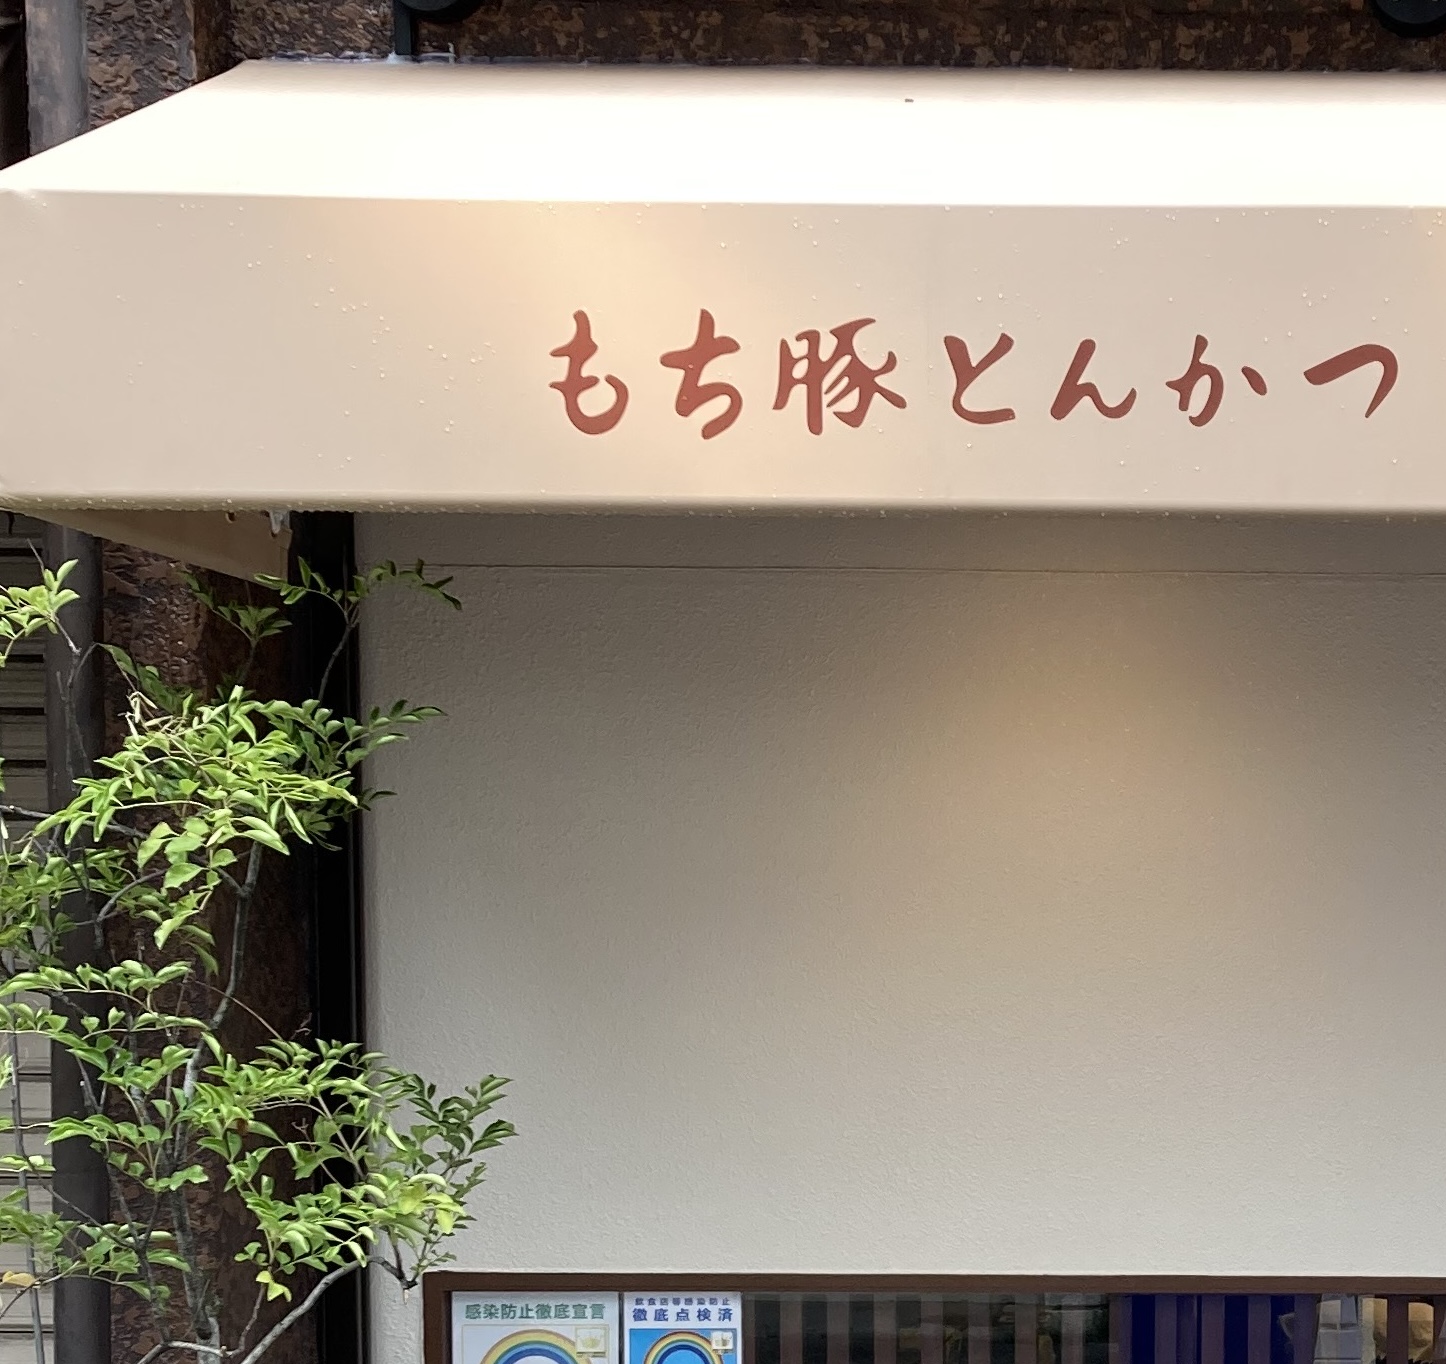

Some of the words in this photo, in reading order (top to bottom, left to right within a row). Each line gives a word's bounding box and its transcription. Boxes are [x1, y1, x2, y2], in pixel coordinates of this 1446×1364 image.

[549, 308, 1400, 440] もち豚とんかつ
[464, 1303, 606, 1321] 感染防止徹底宣言
[632, 1308, 733, 1322] 徹底点検済
